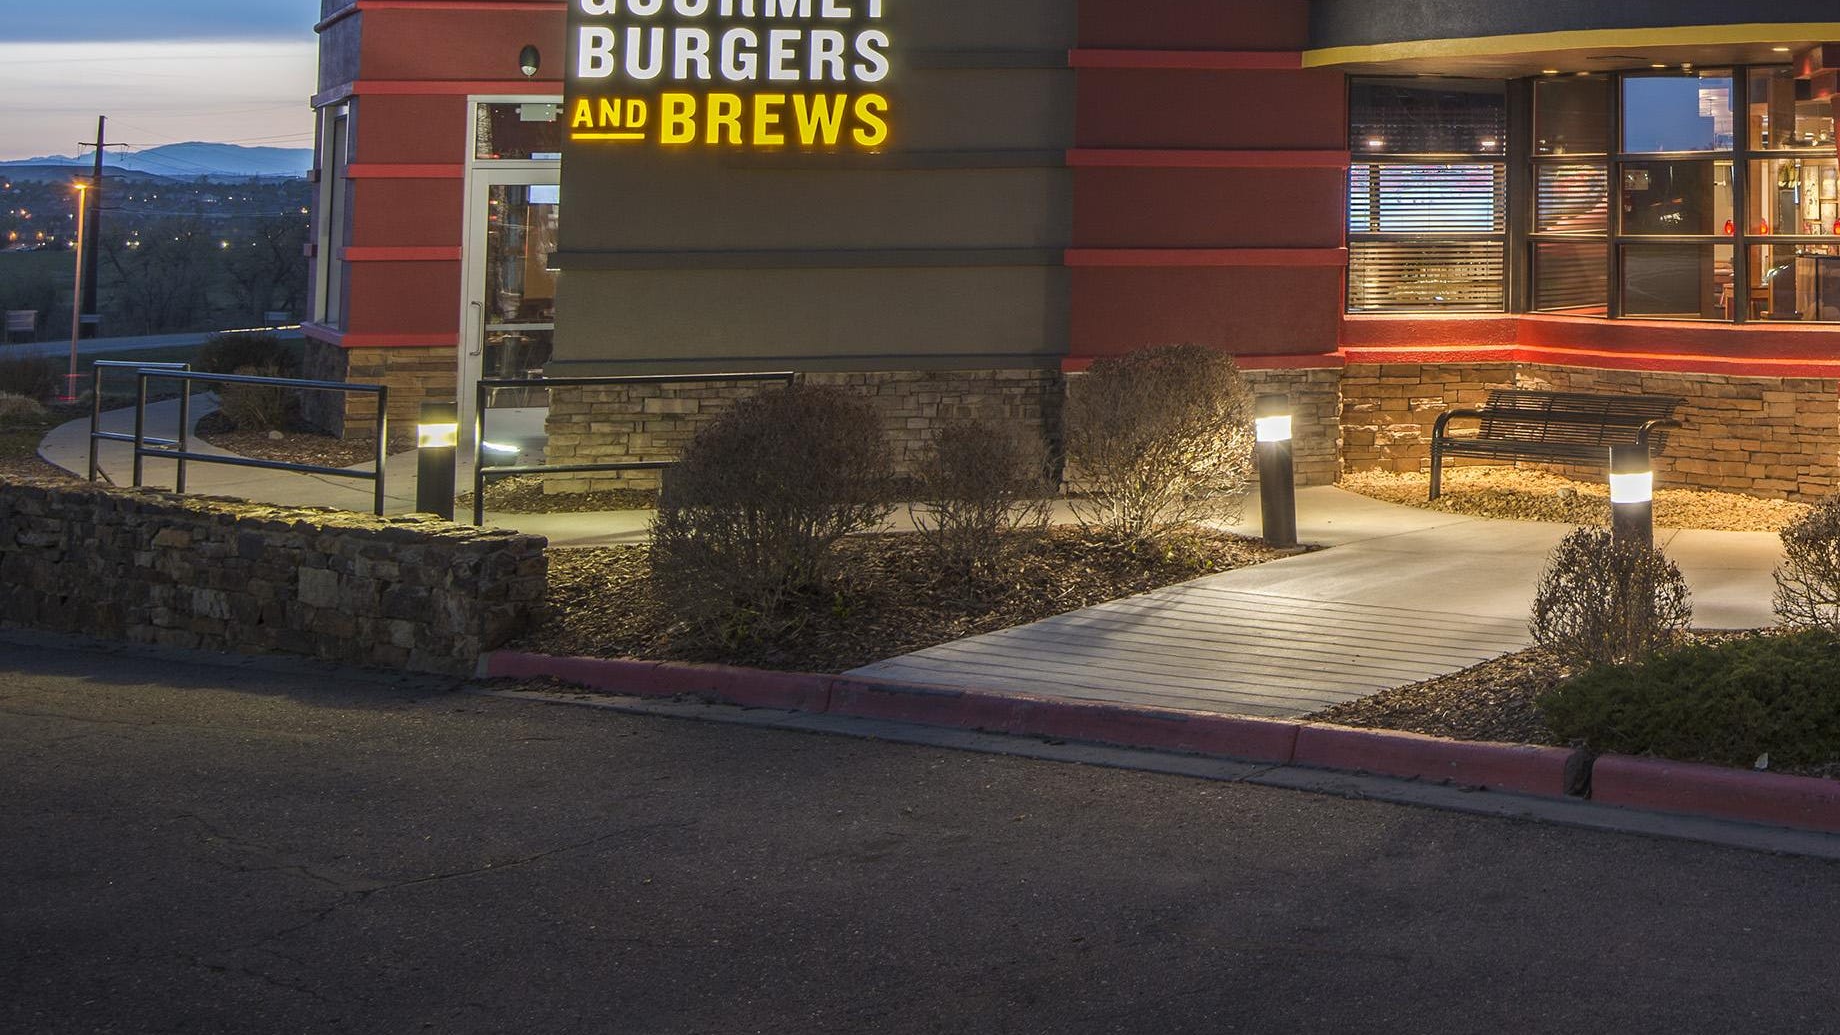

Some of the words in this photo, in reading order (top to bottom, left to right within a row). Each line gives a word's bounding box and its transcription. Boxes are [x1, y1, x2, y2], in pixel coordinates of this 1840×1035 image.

[578, 26, 889, 82] BURGERS
[571, 98, 647, 128] AND
[660, 93, 888, 146] BREWS
